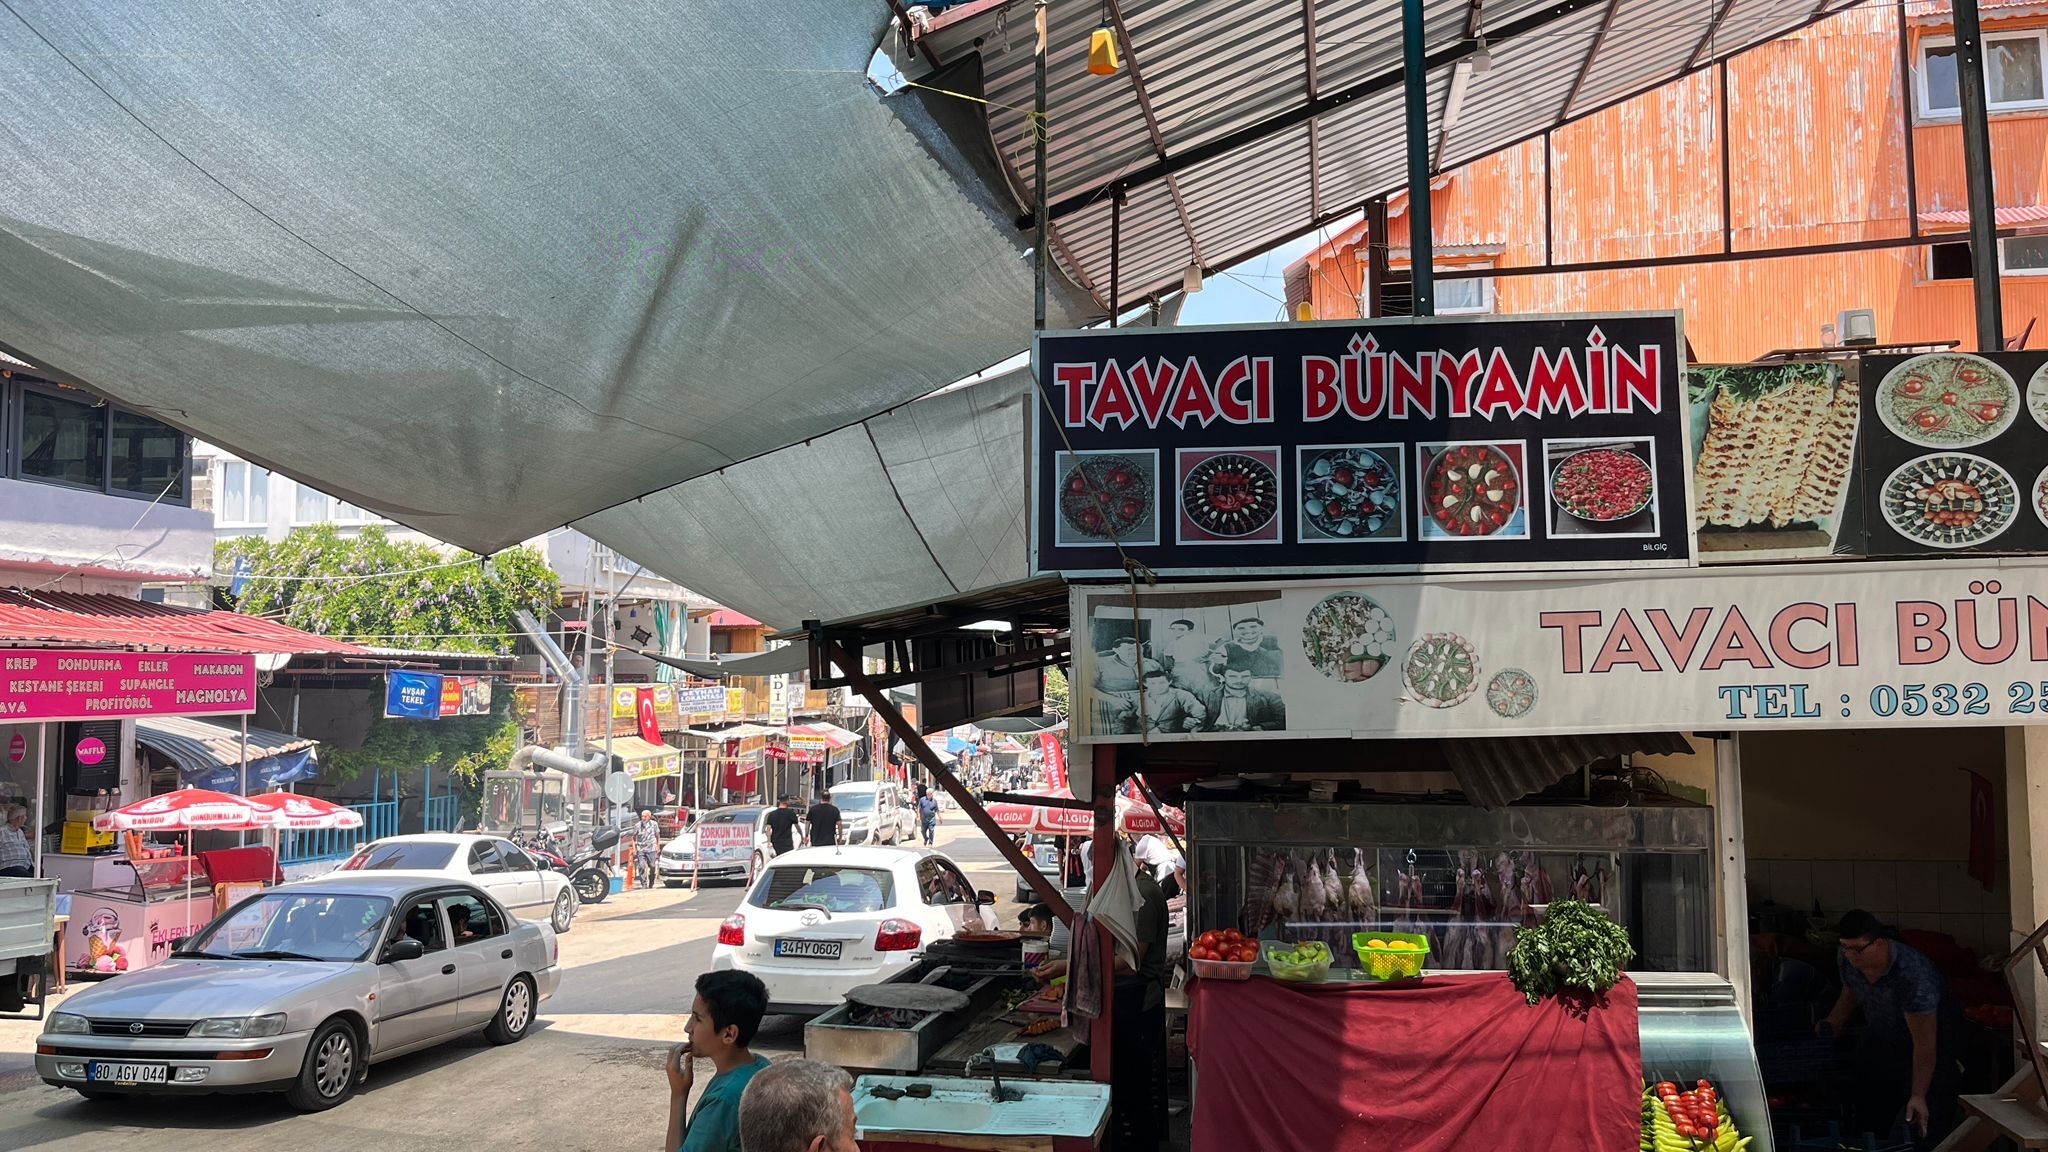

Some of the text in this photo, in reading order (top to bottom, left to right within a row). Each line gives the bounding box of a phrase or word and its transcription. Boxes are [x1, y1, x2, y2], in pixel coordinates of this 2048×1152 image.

[1054, 325, 1662, 432] TAVACI BÜNYAMİN
[1642, 542, 1668, 552] BİLGİÇ
[1540, 602, 1859, 673] TAVACI
[5, 657, 244, 676] KREP DONDURMA EKLER MAKARON
[9, 679, 64, 693] KESTANE
[66, 677, 104, 696] ŞEKERİ
[401, 686, 426, 697] AVŞAR
[85, 695, 153, 710] PROFİTÖRÖL
[175, 688, 248, 704] MAGNOLYA
[401, 694, 424, 705] TEKEL
[1719, 683, 1822, 719] TEL
[1840, 693, 1851, 717] :
[1869, 683, 1990, 718] 0532
[77, 746, 106, 755] WAFFLE
[701, 826, 750, 838] ZORKUN TAVA
[782, 941, 839, 956] 34 HY 0602
[96, 1065, 165, 1081] 80 AGV 044
